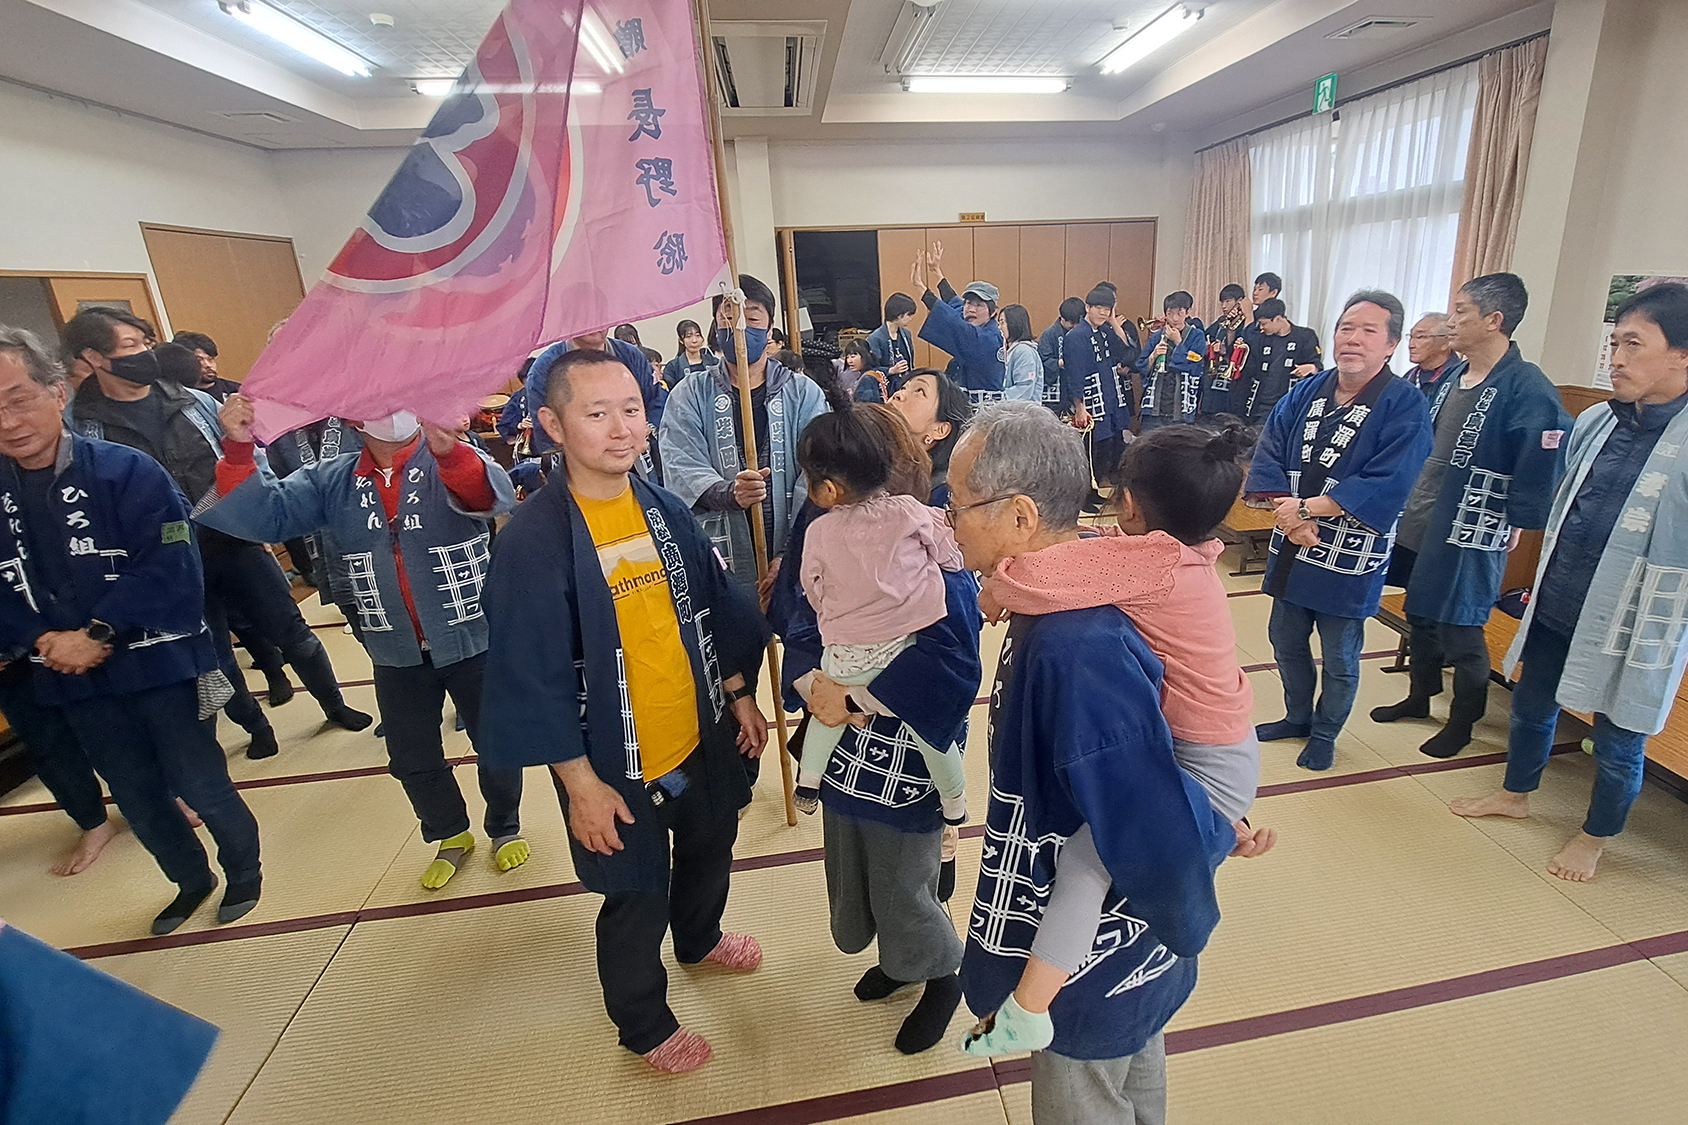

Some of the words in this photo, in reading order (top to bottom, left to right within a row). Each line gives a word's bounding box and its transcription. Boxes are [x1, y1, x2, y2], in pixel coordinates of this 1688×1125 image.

[1301, 398, 1327, 463] 廣澤町
[1319, 405, 1372, 468] 廣澤町
[61, 486, 99, 557] ひろ組
[403, 467, 424, 531] ひろ組
[831, 757, 846, 775] ワ
[869, 746, 889, 762] サ
[902, 785, 920, 800] サ
